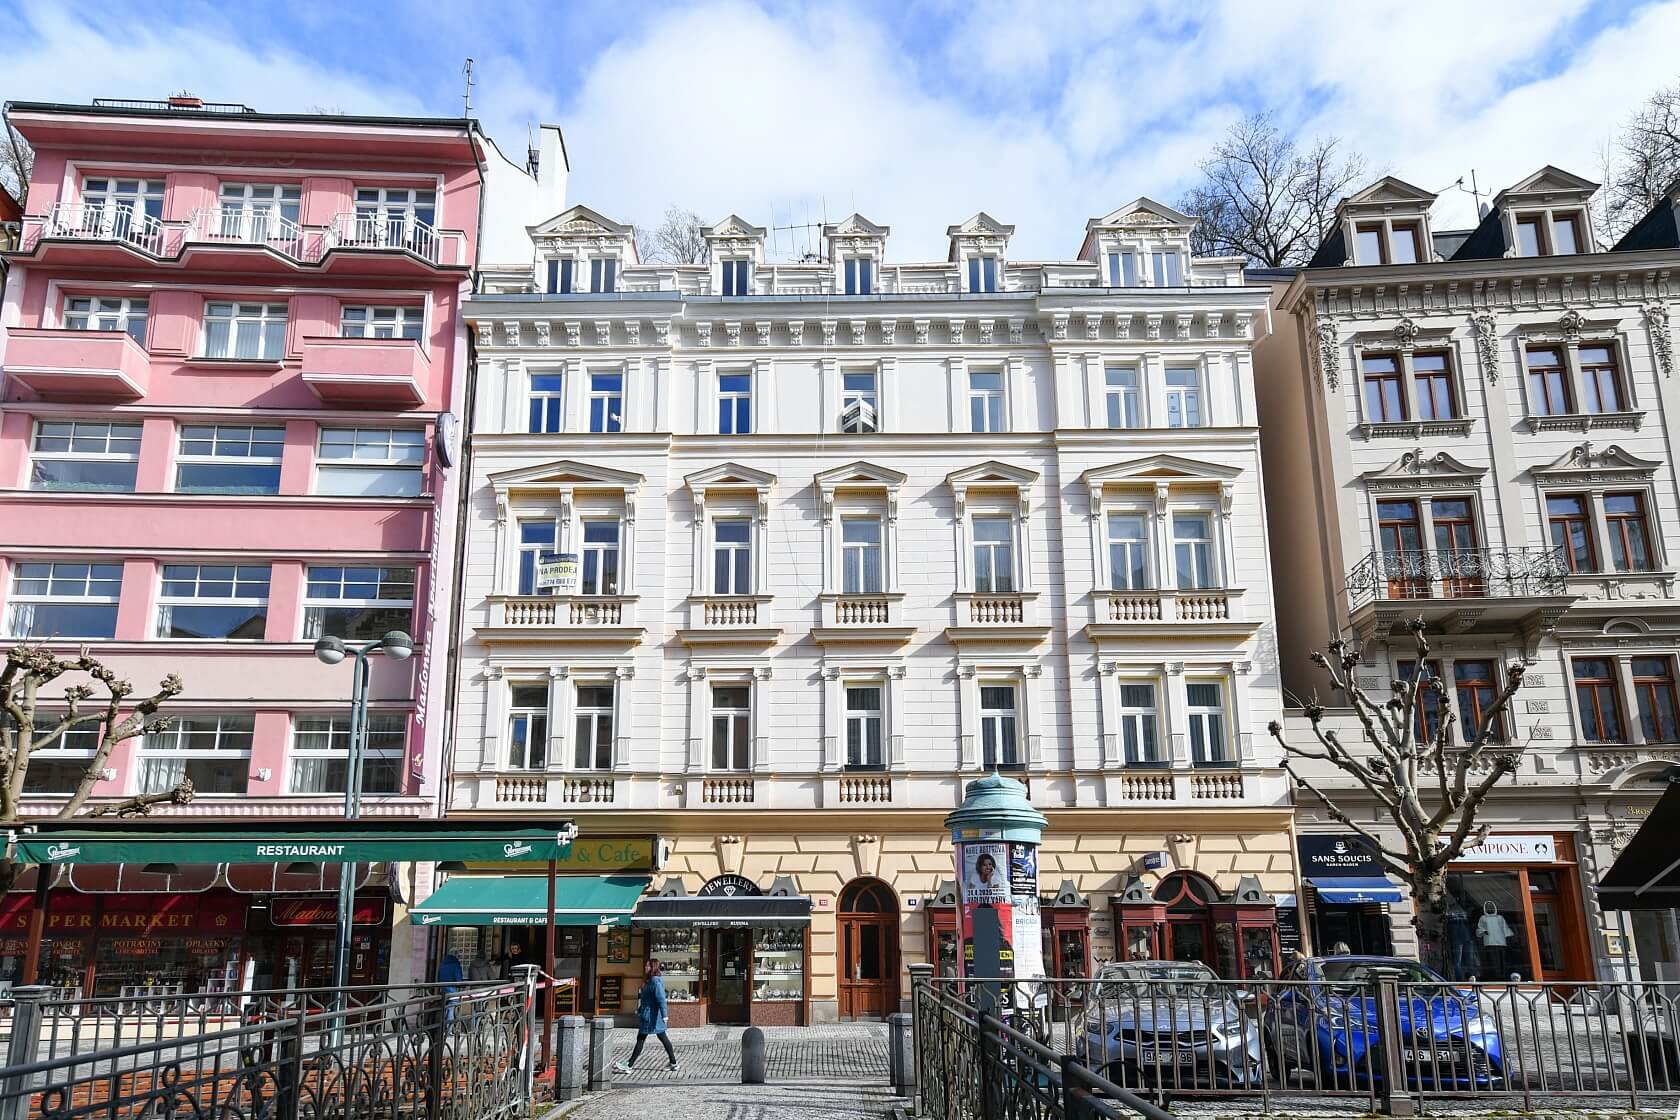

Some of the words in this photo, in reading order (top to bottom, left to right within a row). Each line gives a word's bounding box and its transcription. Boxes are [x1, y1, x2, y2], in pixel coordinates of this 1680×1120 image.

[539, 567, 548, 575] NA
[549, 564, 577, 574] PRODEJ
[415, 630, 432, 728] Madonna
[256, 845, 345, 856] RESTAURANT
[599, 843, 640, 863] Cafe
[1464, 841, 1529, 854] AMPIONE
[1311, 855, 1336, 863] SANS
[704, 876, 756, 895] JEWELLERY
[16, 915, 92, 927] SPER
[102, 914, 193, 927] MARKET
